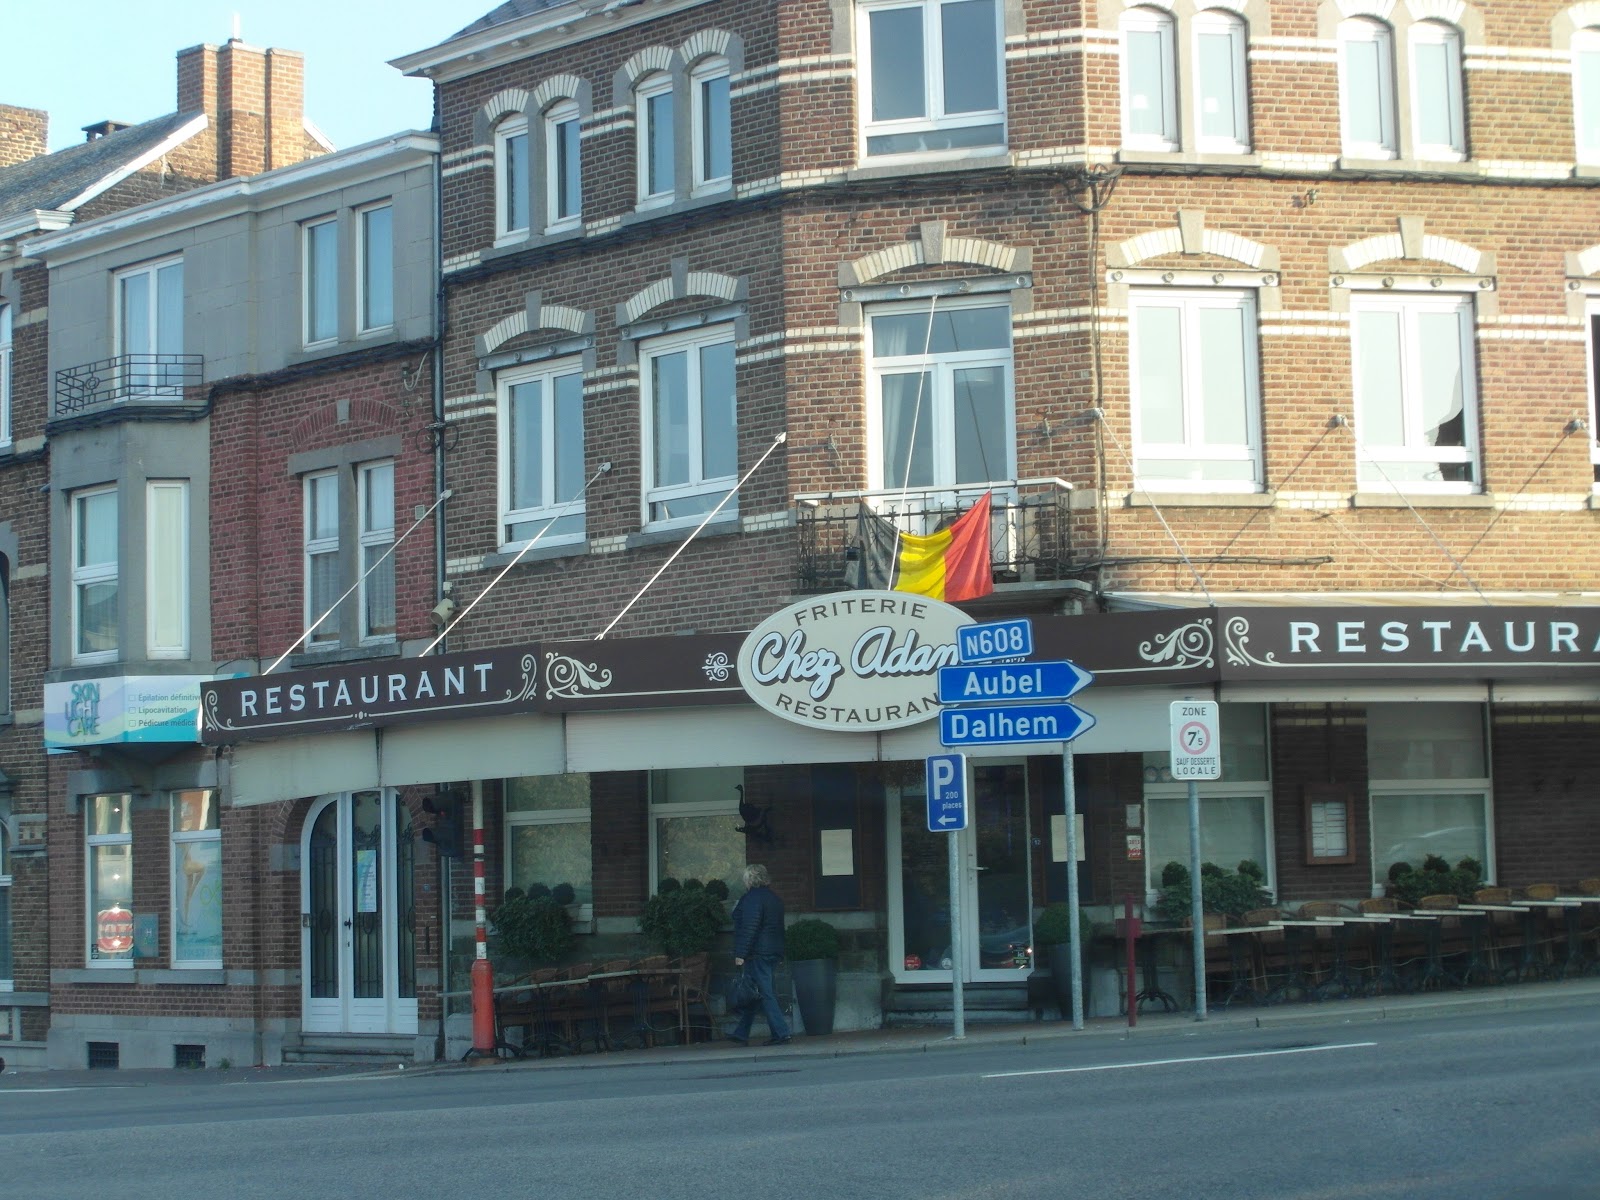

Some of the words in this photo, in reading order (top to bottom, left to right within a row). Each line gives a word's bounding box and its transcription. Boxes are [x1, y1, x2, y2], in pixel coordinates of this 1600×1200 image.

[794, 598, 928, 627] FRITERIE
[966, 626, 1024, 657] N608
[1289, 620, 1600, 653] RESTAUR
[751, 629, 845, 701] Chez
[240, 662, 494, 718] RESTAURANT
[963, 668, 1042, 696] Aubel
[138, 706, 188, 715] Lipocavitation
[775, 692, 941, 723] RESTAURAN
[1182, 707, 1207, 716] ZONE
[138, 718, 169, 727] Pédicure
[951, 712, 1058, 739] Dalhem
[1176, 757, 1190, 766] SAUF
[1190, 757, 1216, 766] DESSERTE
[1176, 766, 1216, 775] LOCALE
[932, 758, 954, 801] P
[942, 802, 963, 812] places
[945, 791, 959, 800] 200
